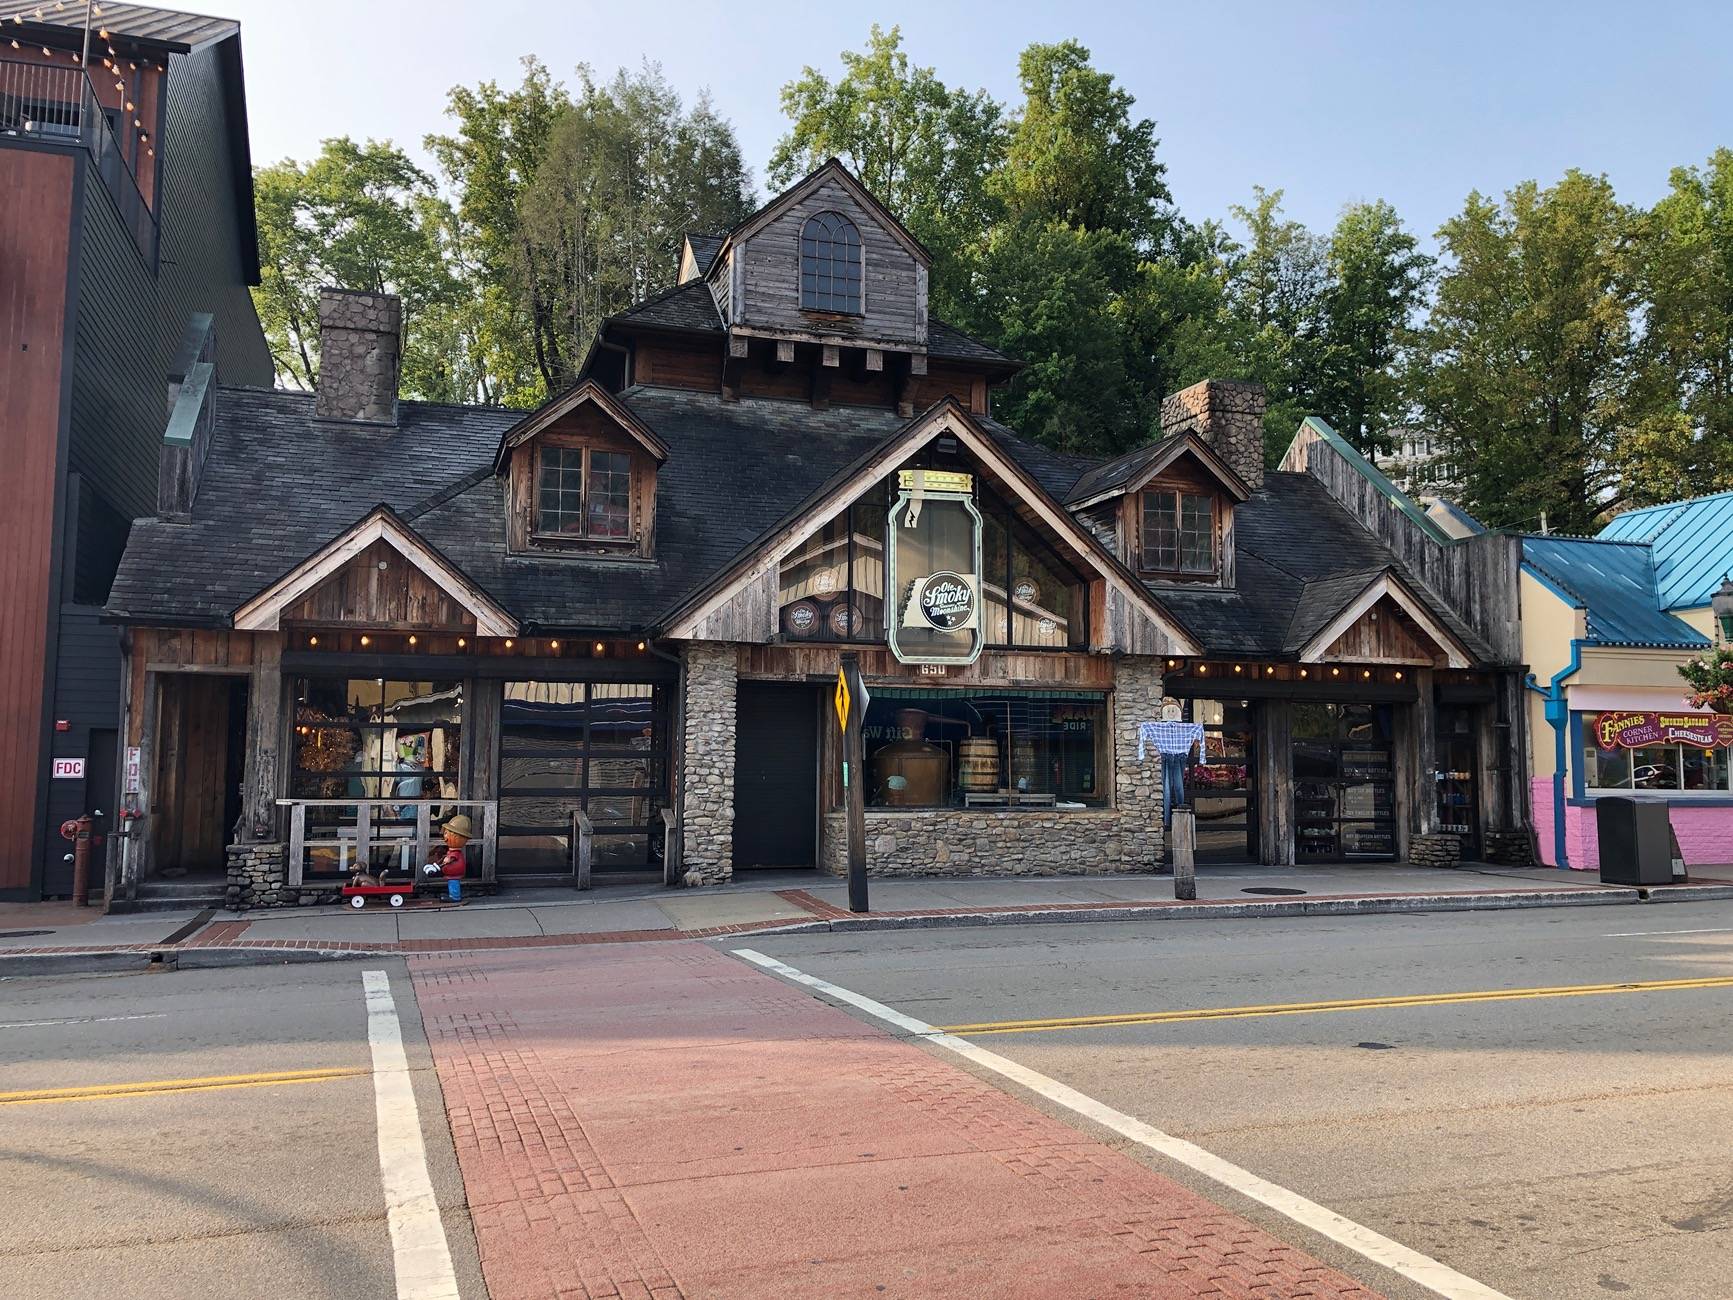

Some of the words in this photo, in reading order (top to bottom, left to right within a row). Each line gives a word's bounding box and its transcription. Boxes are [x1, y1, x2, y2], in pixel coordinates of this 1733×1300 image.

[940, 582, 957, 593] Ole
[923, 585, 971, 607] Smoky
[1622, 725, 1653, 738] CORNER
[1626, 731, 1659, 745] KITCHEN
[1668, 727, 1713, 743] CHEESESTEAK
[56, 762, 81, 774] FDC
